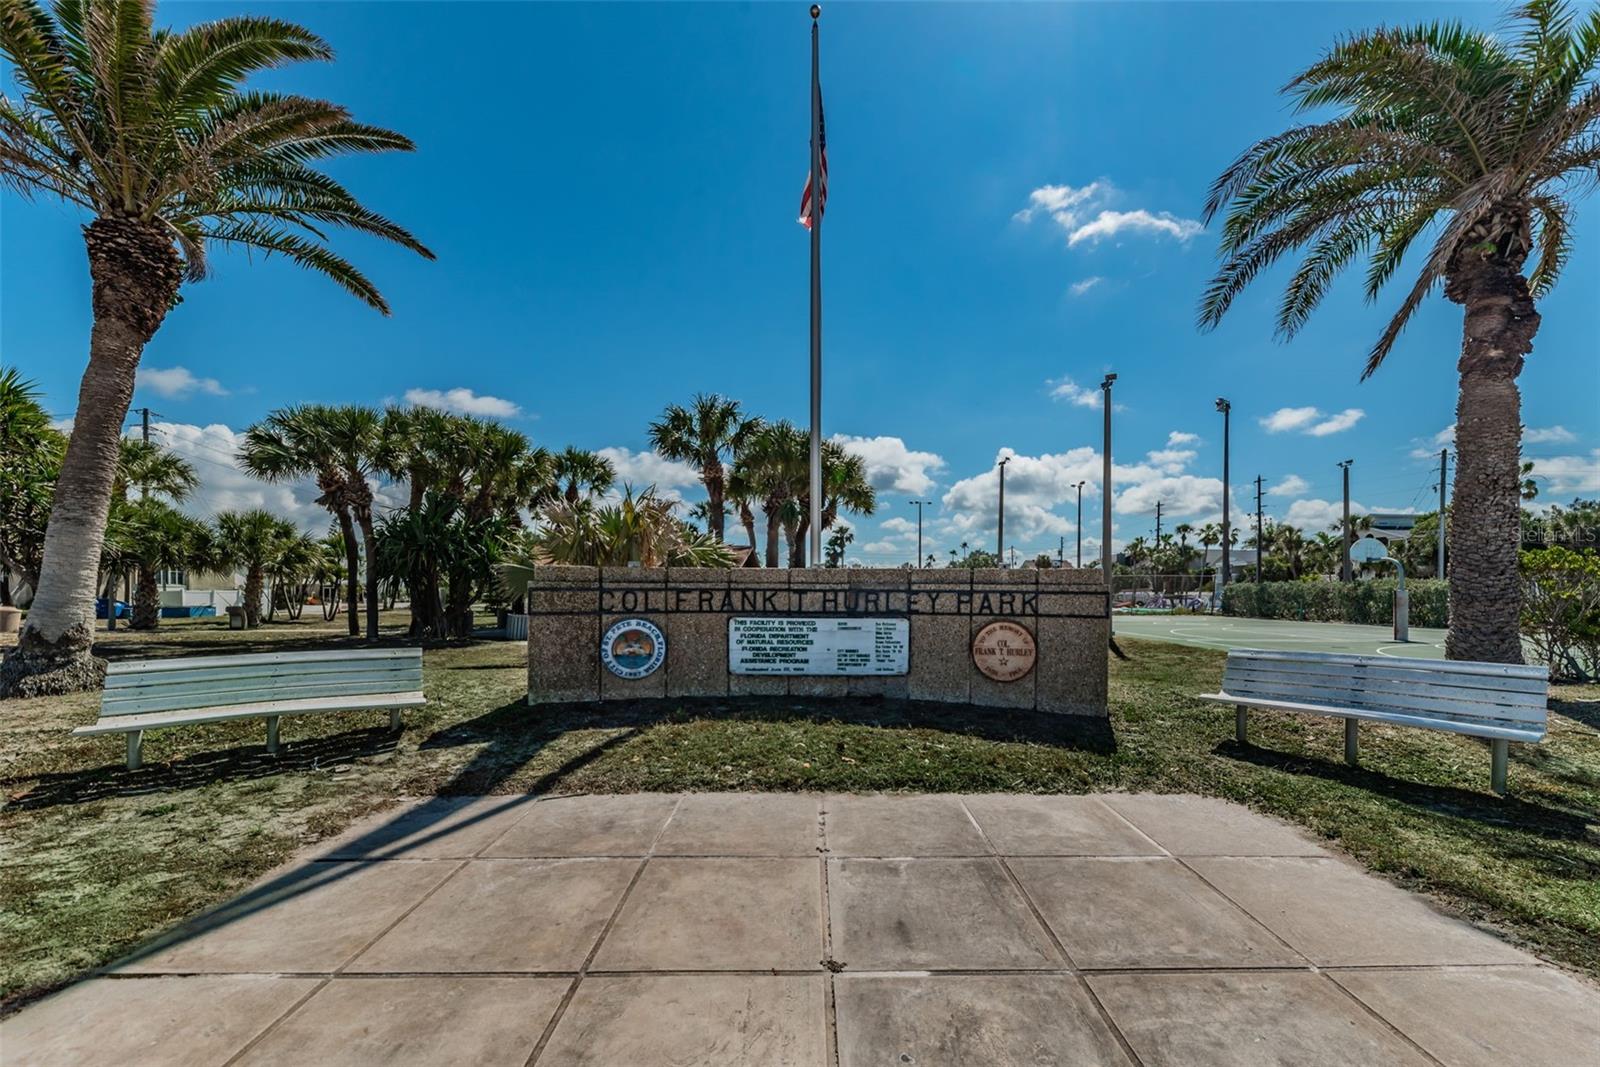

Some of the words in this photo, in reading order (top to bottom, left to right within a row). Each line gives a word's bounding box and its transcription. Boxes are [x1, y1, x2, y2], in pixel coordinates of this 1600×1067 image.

[676, 590, 779, 612] FRANK
[792, 591, 807, 612] T
[823, 592, 940, 614] HURLEY
[958, 592, 1038, 614] PARK
[612, 621, 632, 634] PETE
[999, 625, 1023, 636] MEMORY
